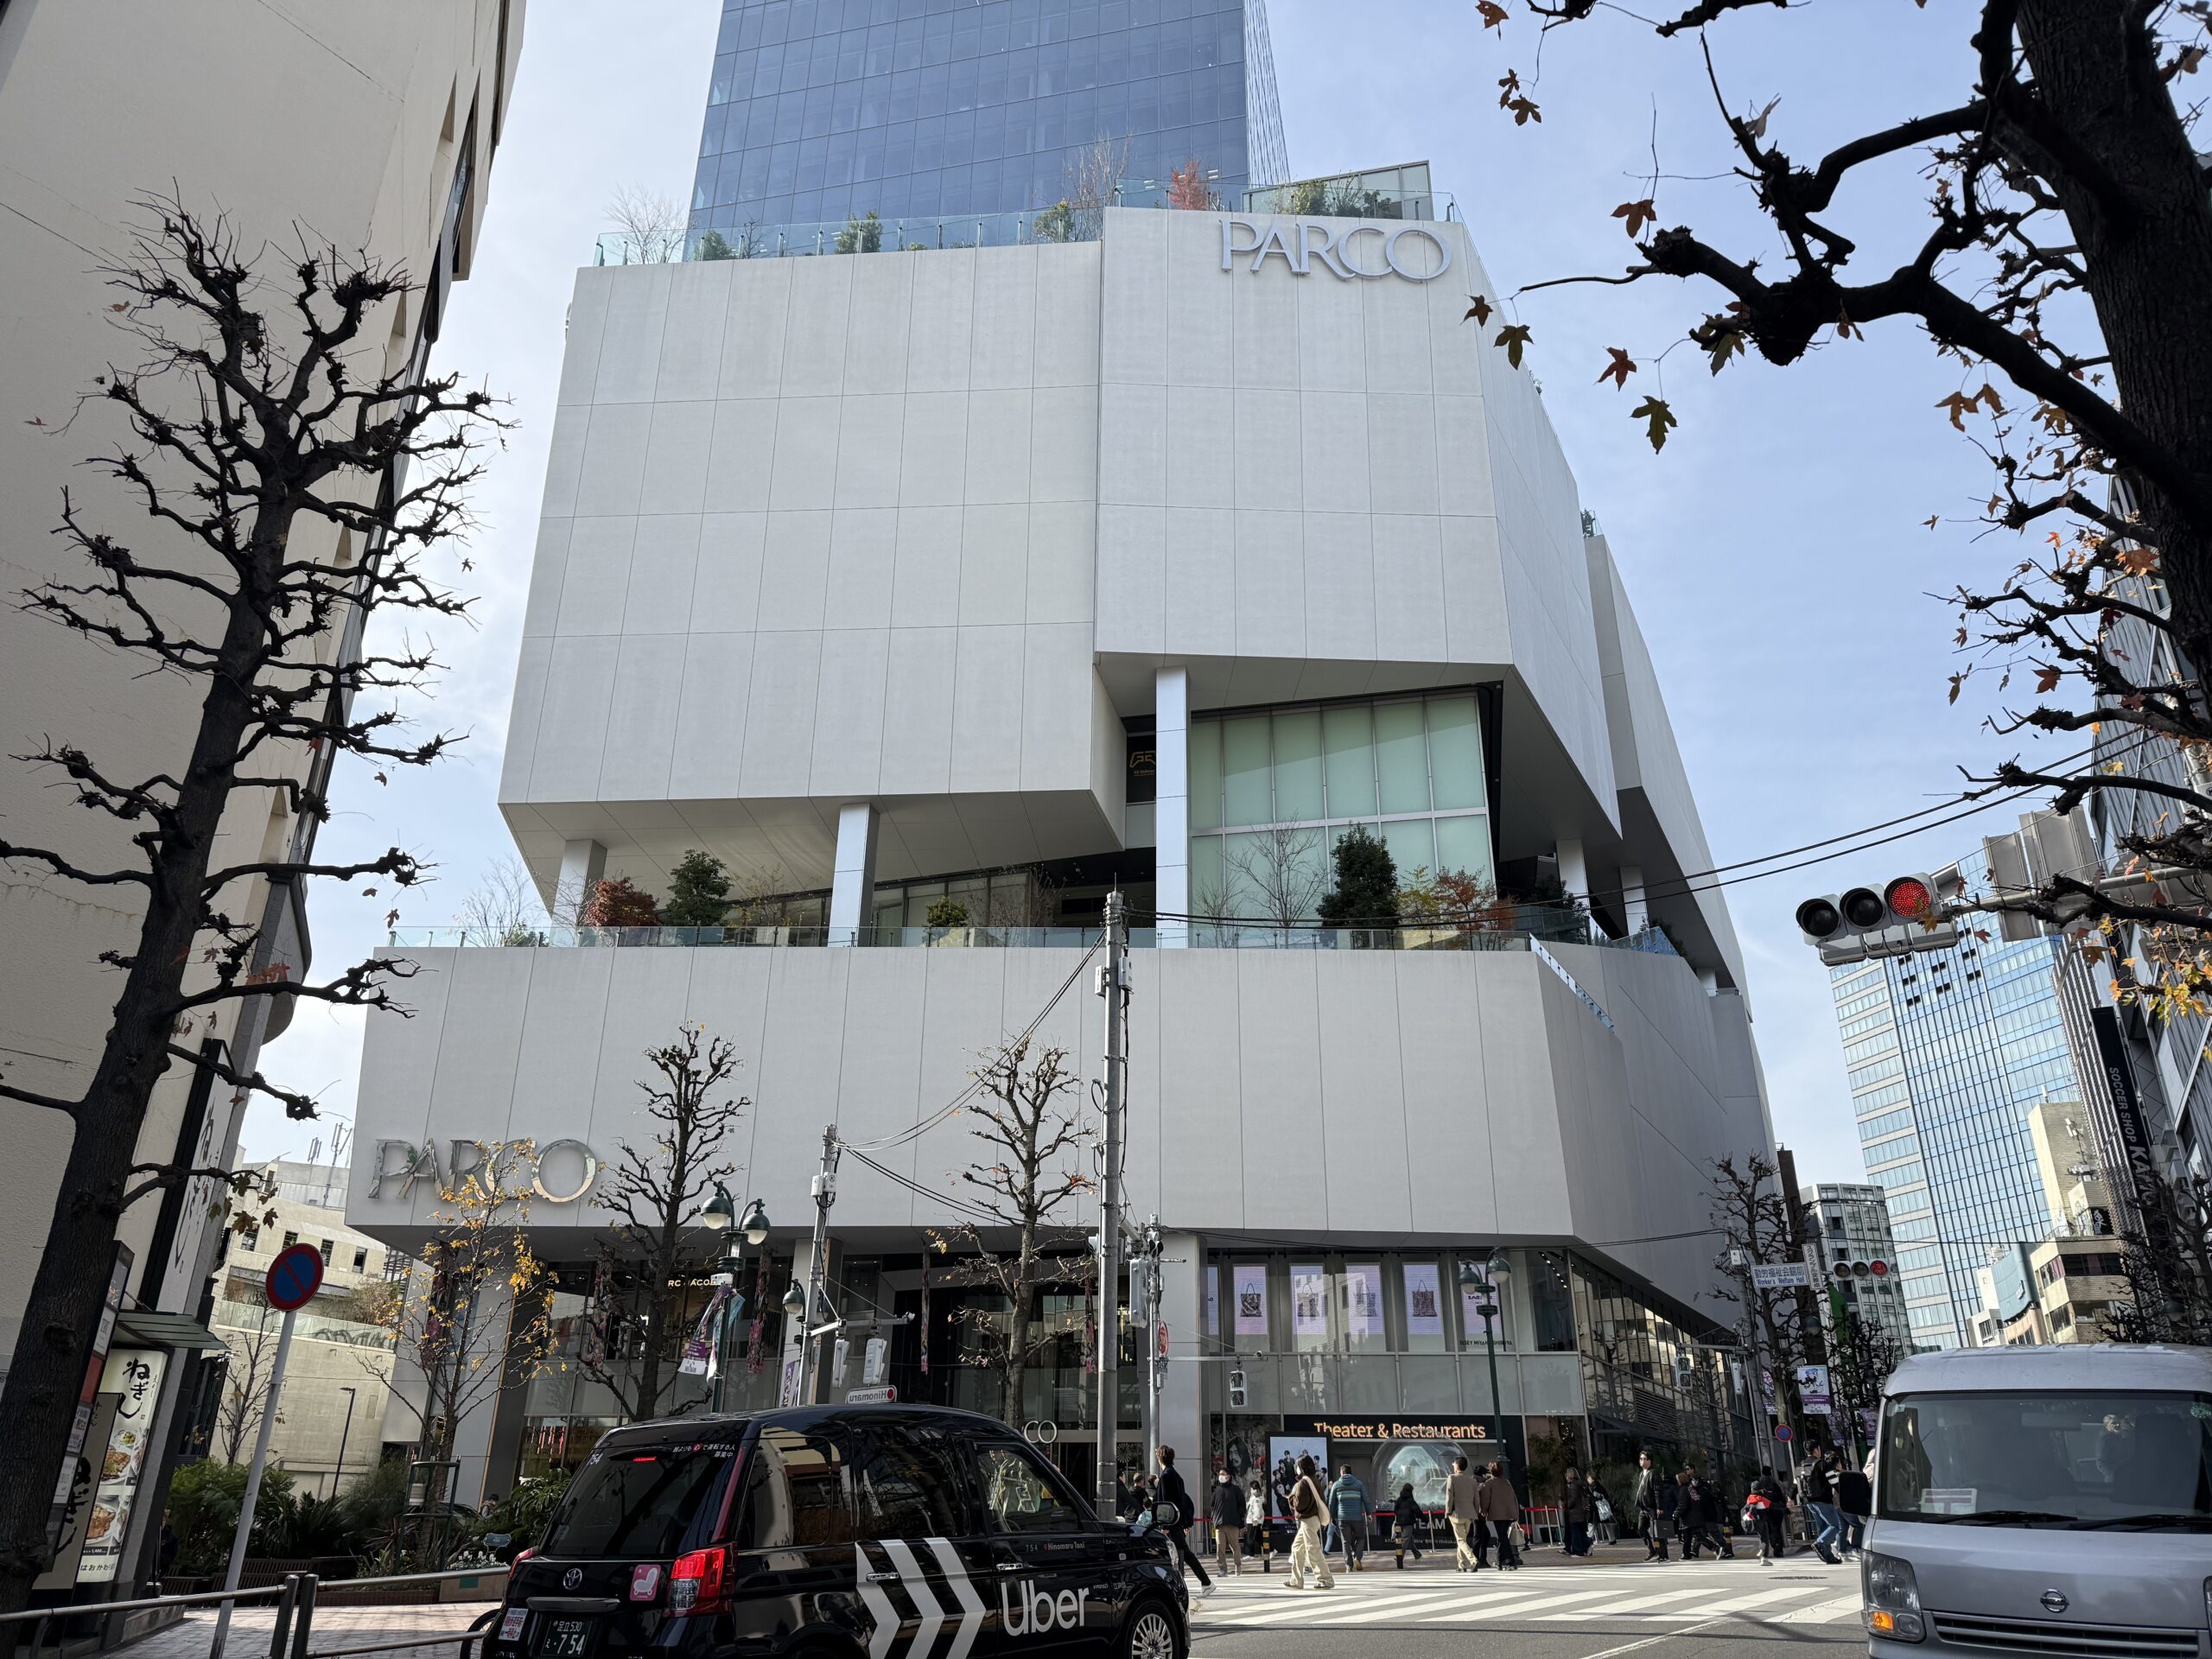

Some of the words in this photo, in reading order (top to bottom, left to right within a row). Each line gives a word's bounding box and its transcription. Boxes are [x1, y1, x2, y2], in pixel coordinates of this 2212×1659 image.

[1218, 218, 1452, 283] PARCO
[2108, 1066, 2129, 1109] SOCCER
[2120, 1111, 2138, 1142] SHOP
[367, 1137, 597, 1203] PARCO
[118, 1357, 150, 1420] ねぎし
[1313, 1421, 1374, 1439] Theater
[1377, 1422, 1389, 1439] &
[1392, 1422, 1486, 1440] Restaurants
[1025, 1543, 1039, 1553] 754
[1047, 1541, 1074, 1551] Hinomaru
[1073, 1541, 1085, 1550] Taxi
[1413, 1517, 1446, 1530] TEAM
[1000, 1579, 1090, 1637] Uber
